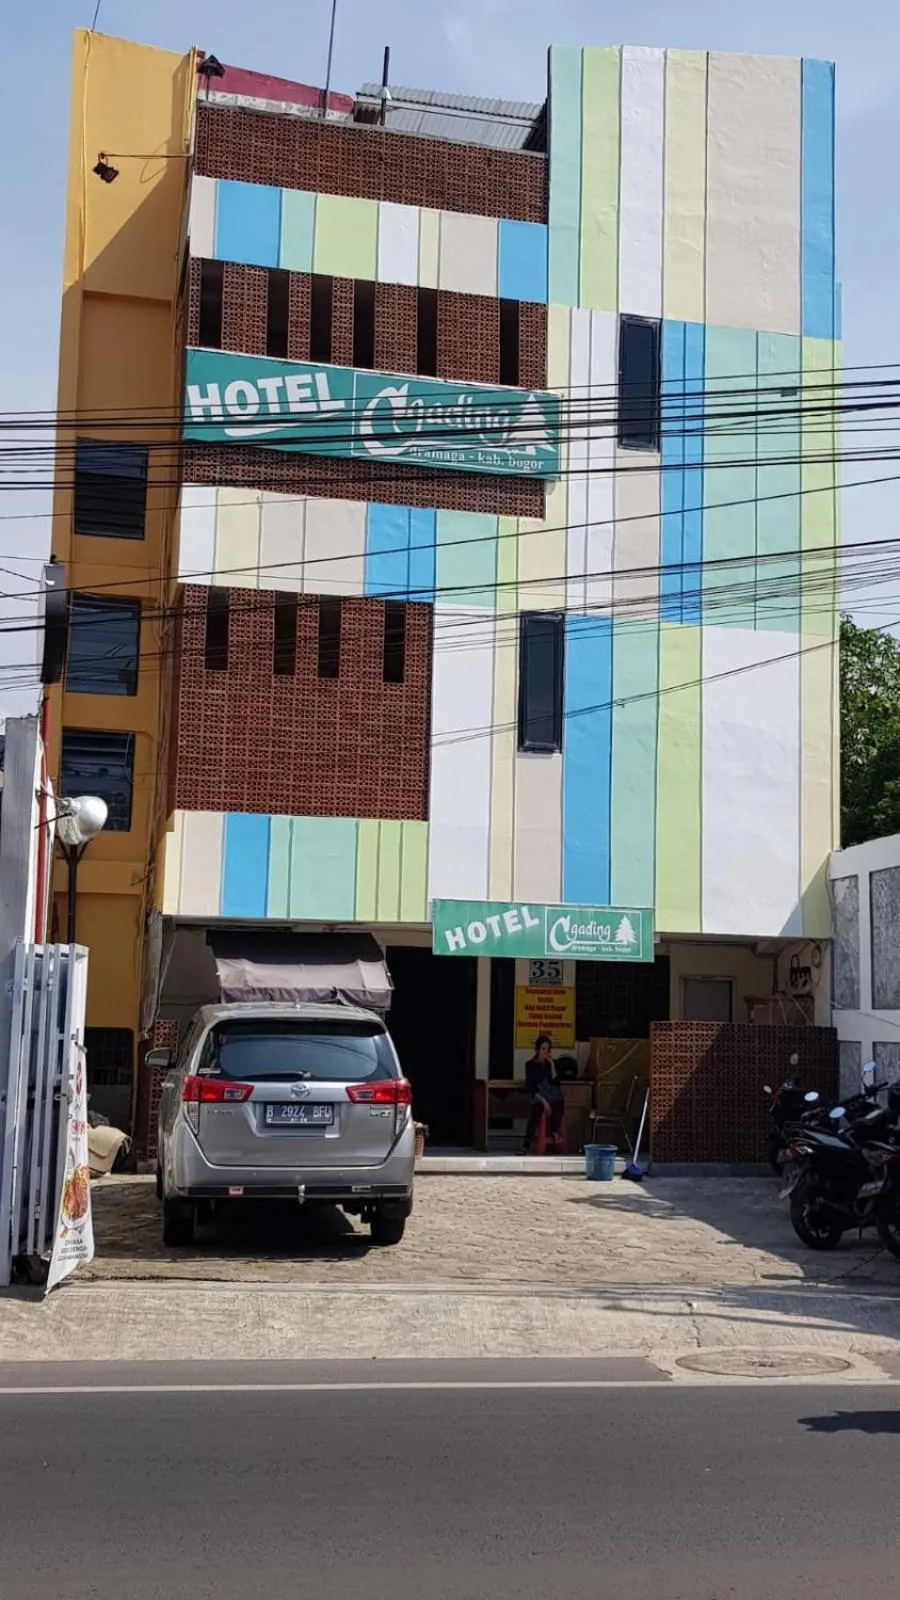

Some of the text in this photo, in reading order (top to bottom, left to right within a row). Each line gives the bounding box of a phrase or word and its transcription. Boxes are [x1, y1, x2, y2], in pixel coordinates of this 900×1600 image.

[186, 372, 346, 423] HOTEL
[409, 446, 465, 462] dramaga
[477, 452, 505, 466] kab.
[508, 454, 545, 471] bogor
[444, 906, 540, 951] HOTEL
[532, 960, 560, 978] 35
[266, 1104, 274, 1117] B
[281, 1105, 305, 1118] 2924
